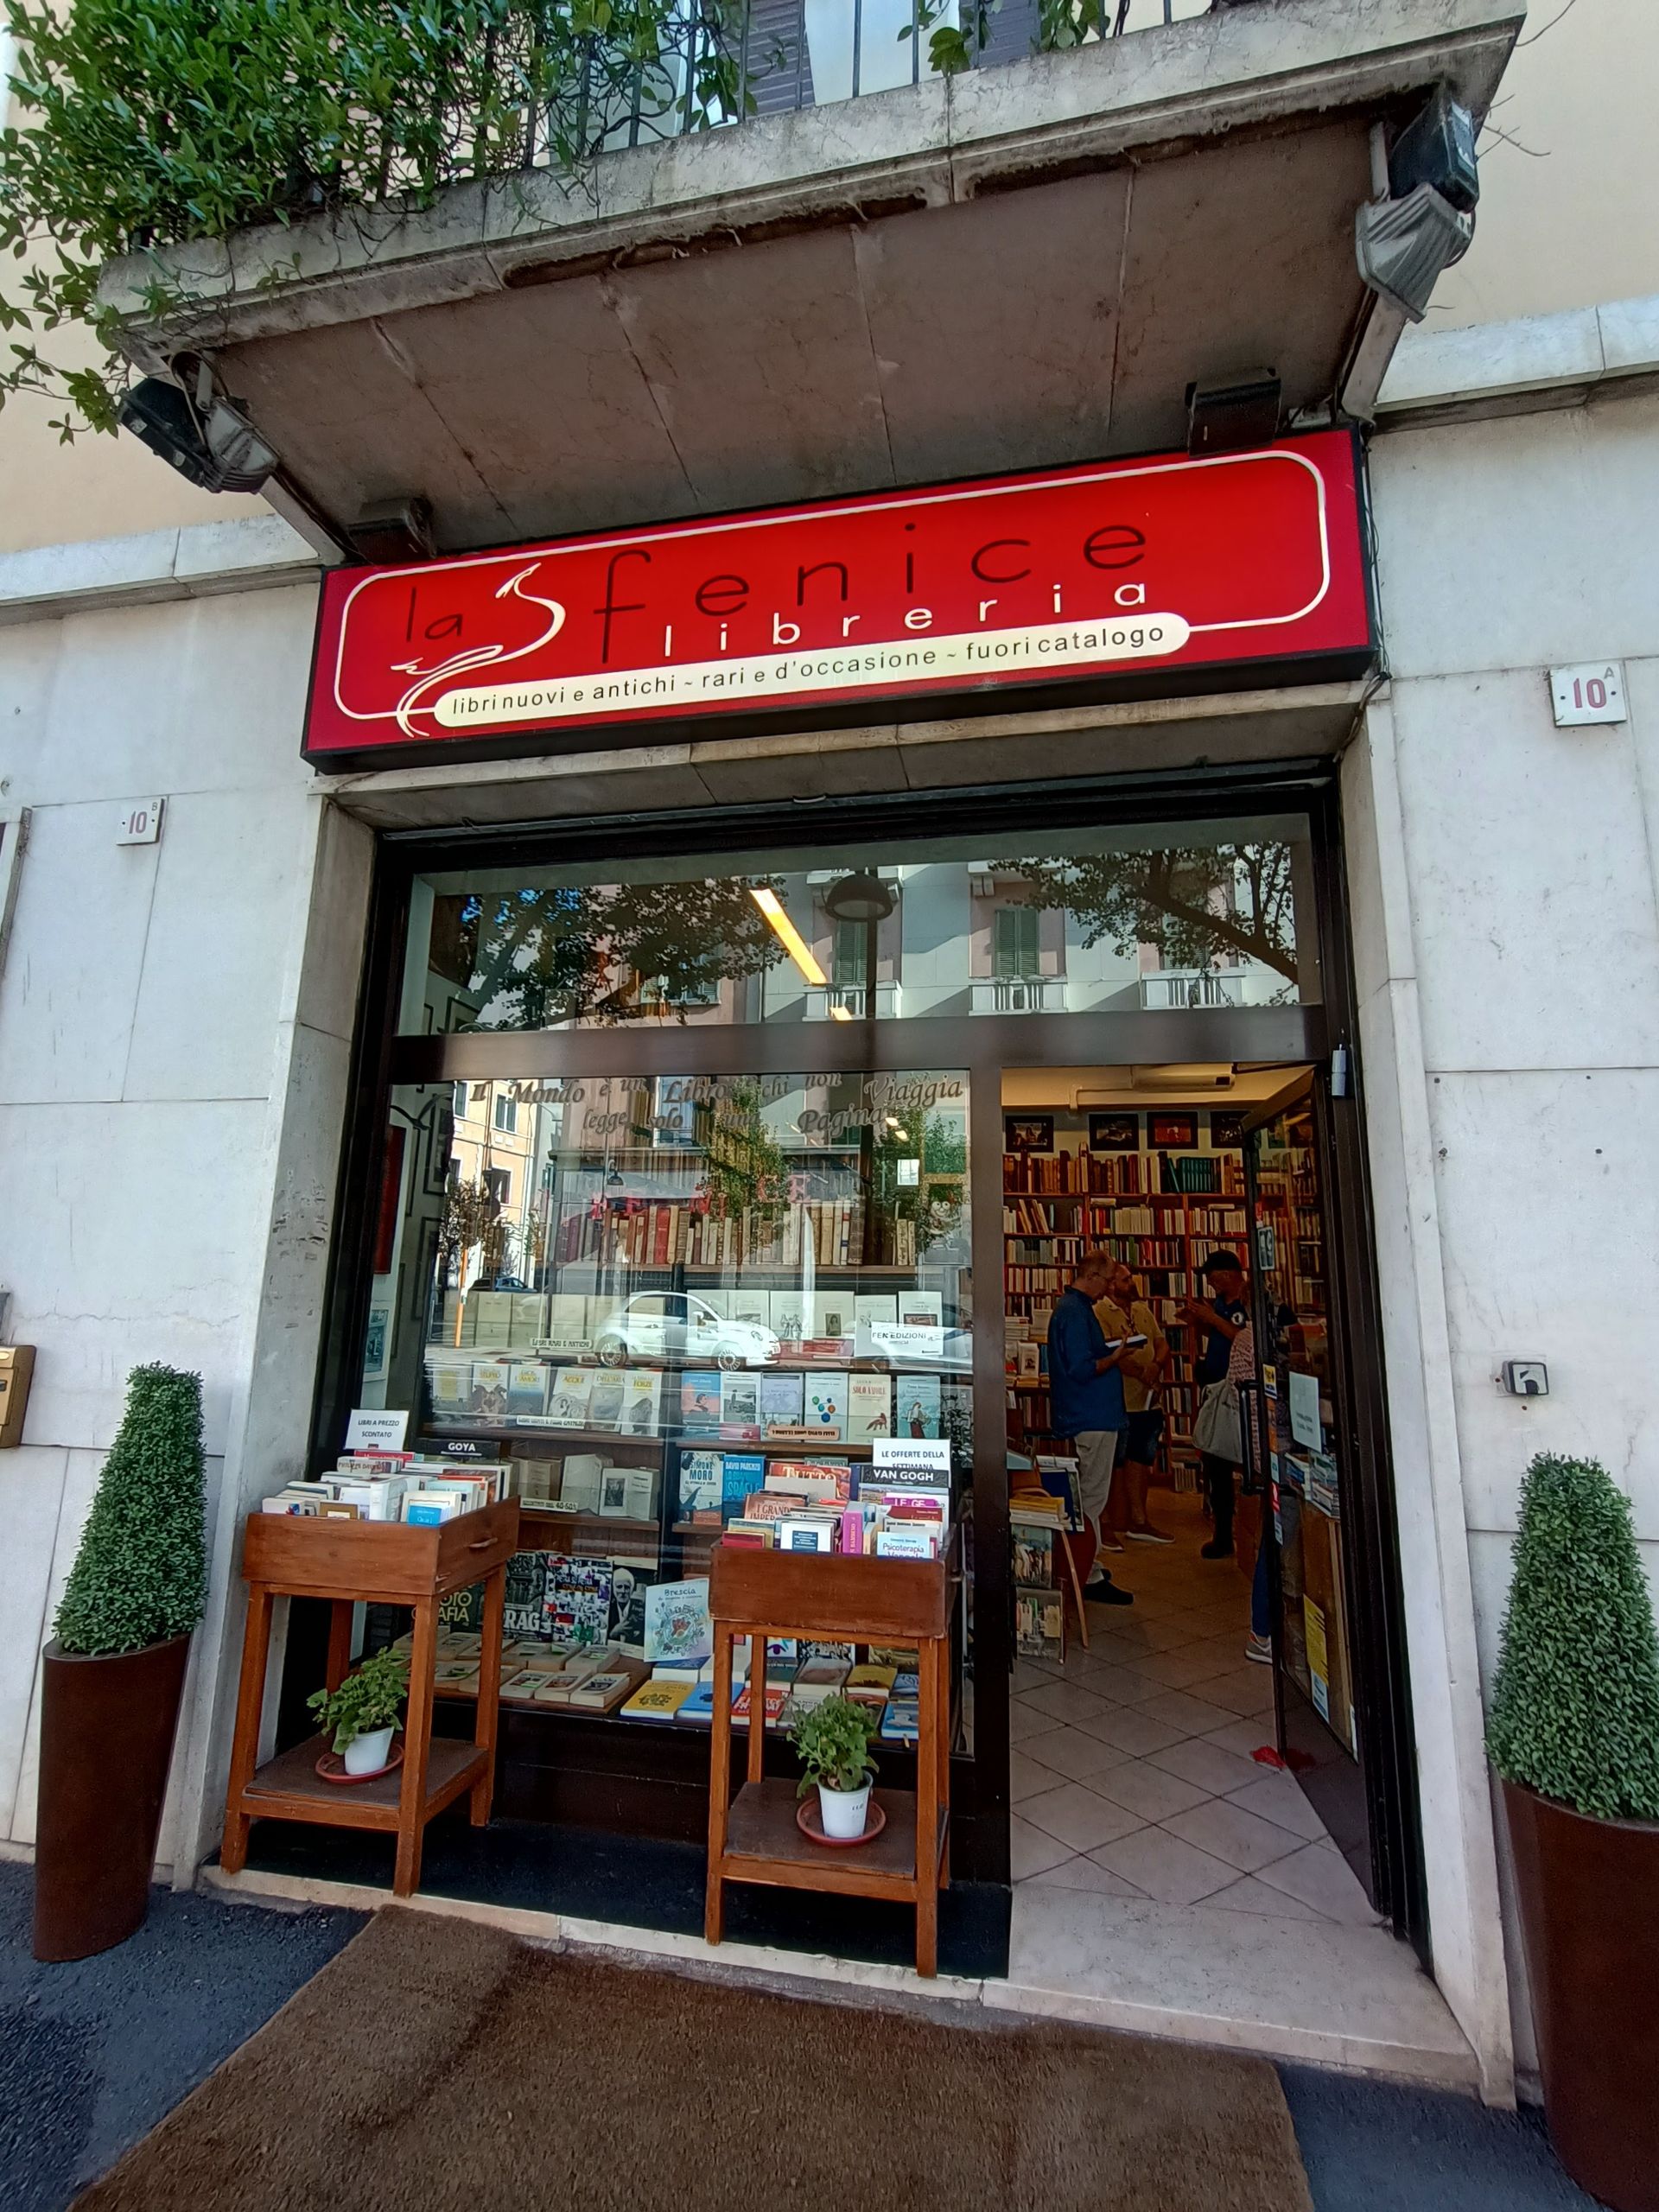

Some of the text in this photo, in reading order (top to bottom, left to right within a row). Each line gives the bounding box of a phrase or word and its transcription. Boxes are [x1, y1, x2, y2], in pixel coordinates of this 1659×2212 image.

[405, 523, 1147, 664] la fenice
[664, 582, 1147, 658] libreria
[453, 626, 1164, 715] libri nuovi e antichi rari e d'occasione fuori catalogo
[1573, 677, 1607, 709] 10
[128, 810, 148, 834] 10
[508, 1079, 586, 1104] Mondo
[761, 1075, 790, 1098] chi
[806, 1072, 842, 1089] non
[864, 1073, 963, 1108] Viaggia
[648, 1107, 684, 1129] solo
[797, 1103, 884, 1139] Pagina
[448, 1442, 476, 1452] GOYA
[689, 1470, 713, 1480] MORO
[873, 1469, 934, 1482] VAN GOGH
[762, 1503, 791, 1515] GRAND
[882, 1542, 925, 1554] Psicoterapia
[664, 1587, 696, 1596] Brescia
[438, 1606, 470, 1622] AFIA
[504, 1609, 541, 1631] RAG
